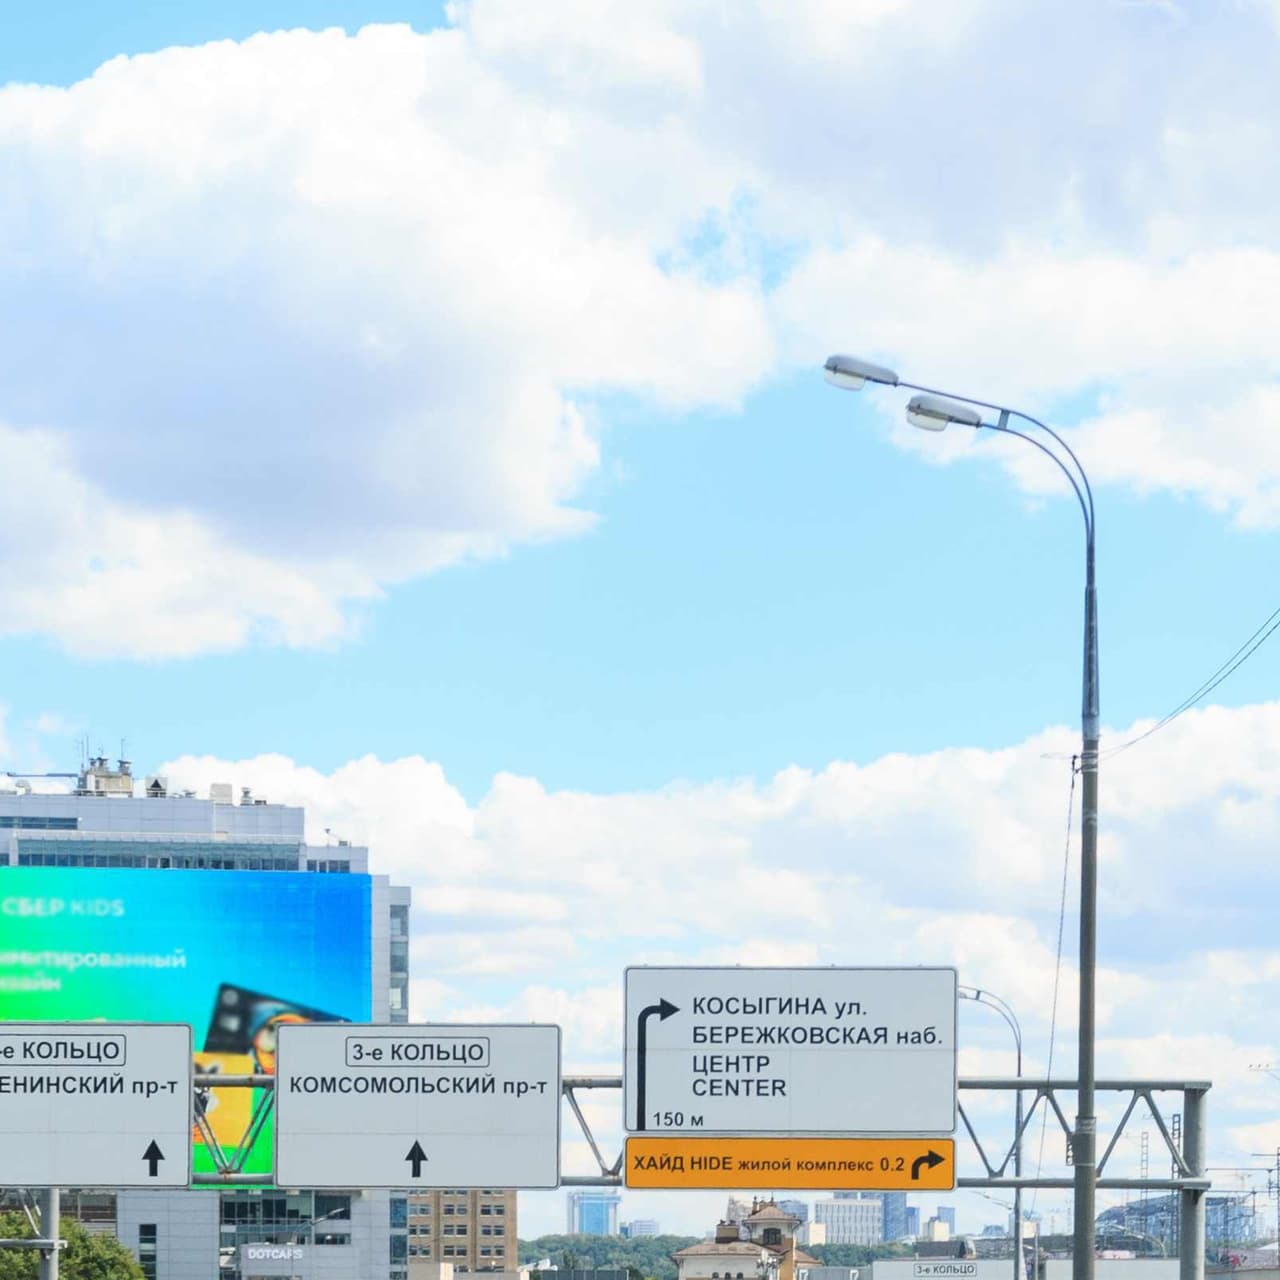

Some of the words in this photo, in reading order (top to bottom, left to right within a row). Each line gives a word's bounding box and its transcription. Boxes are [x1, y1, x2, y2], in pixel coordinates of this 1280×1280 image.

[1, 897, 65, 917] СБЕР
[71, 897, 126, 917] KIDS
[693, 996, 827, 1015] КОСЫГИНА
[835, 1001, 867, 1019] ул.
[693, 1026, 888, 1045] БЕРЕЖКОВСКАЯ
[897, 1027, 943, 1045] наб.
[23, 1041, 120, 1063] КОЛЬЦО
[352, 1043, 383, 1061] 3-е
[391, 1043, 484, 1064] КОЛЬЦО
[693, 1055, 770, 1076] ЦЕНТР
[132, 1080, 178, 1098] пр-т
[290, 1073, 495, 1094] КОМСОМОЛЬСКИЙ
[503, 1081, 548, 1098] пр-т
[692, 1078, 786, 1097] CENTER
[653, 1111, 684, 1127] 150
[690, 1115, 704, 1127] м
[633, 1153, 685, 1173] ХАЙД
[690, 1156, 733, 1171] HIDE
[737, 1157, 791, 1171] жилой
[796, 1160, 874, 1172] комплекс
[880, 1157, 905, 1172] 0.2
[933, 1265, 975, 1275] КОЛЬЦО
